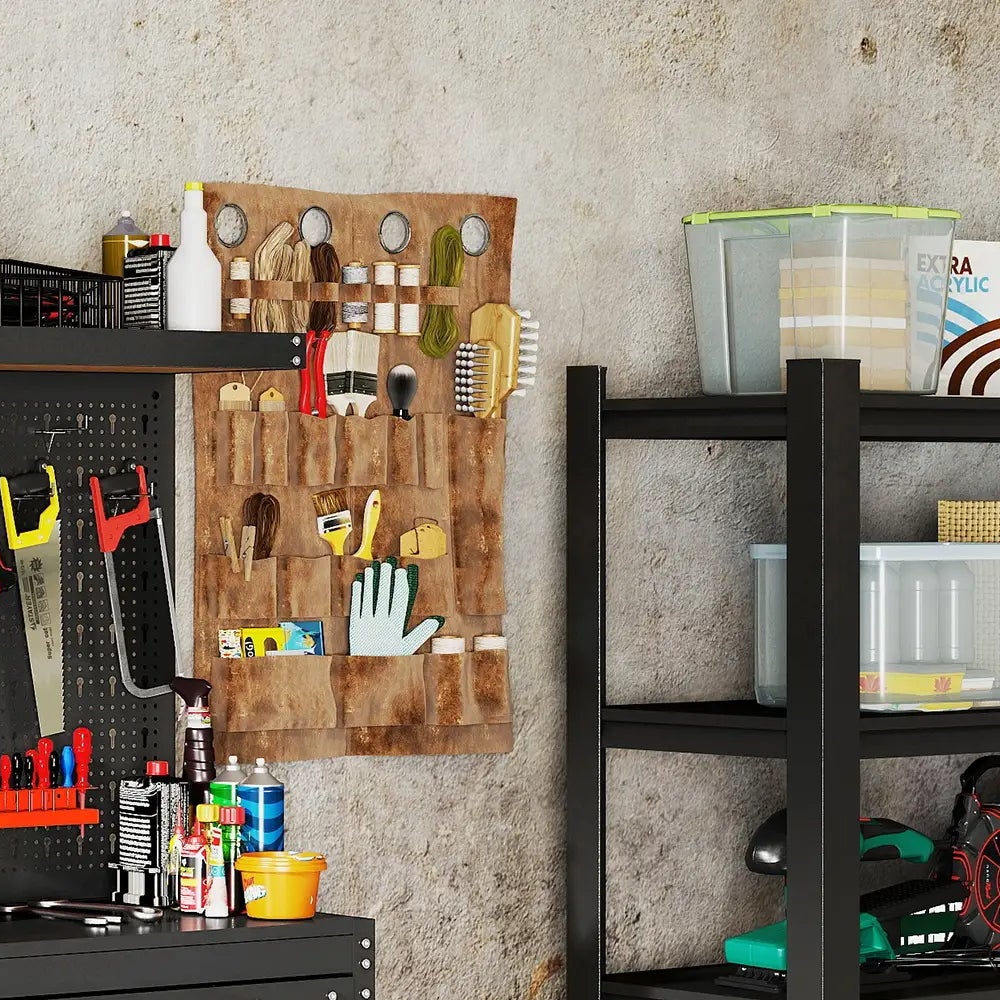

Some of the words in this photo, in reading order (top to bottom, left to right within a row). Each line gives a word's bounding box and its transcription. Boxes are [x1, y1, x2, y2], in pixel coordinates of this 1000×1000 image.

[917, 253, 973, 275] EXTRA
[917, 275, 990, 293] ACRYLIC
[25, 593, 36, 622] STAYER
